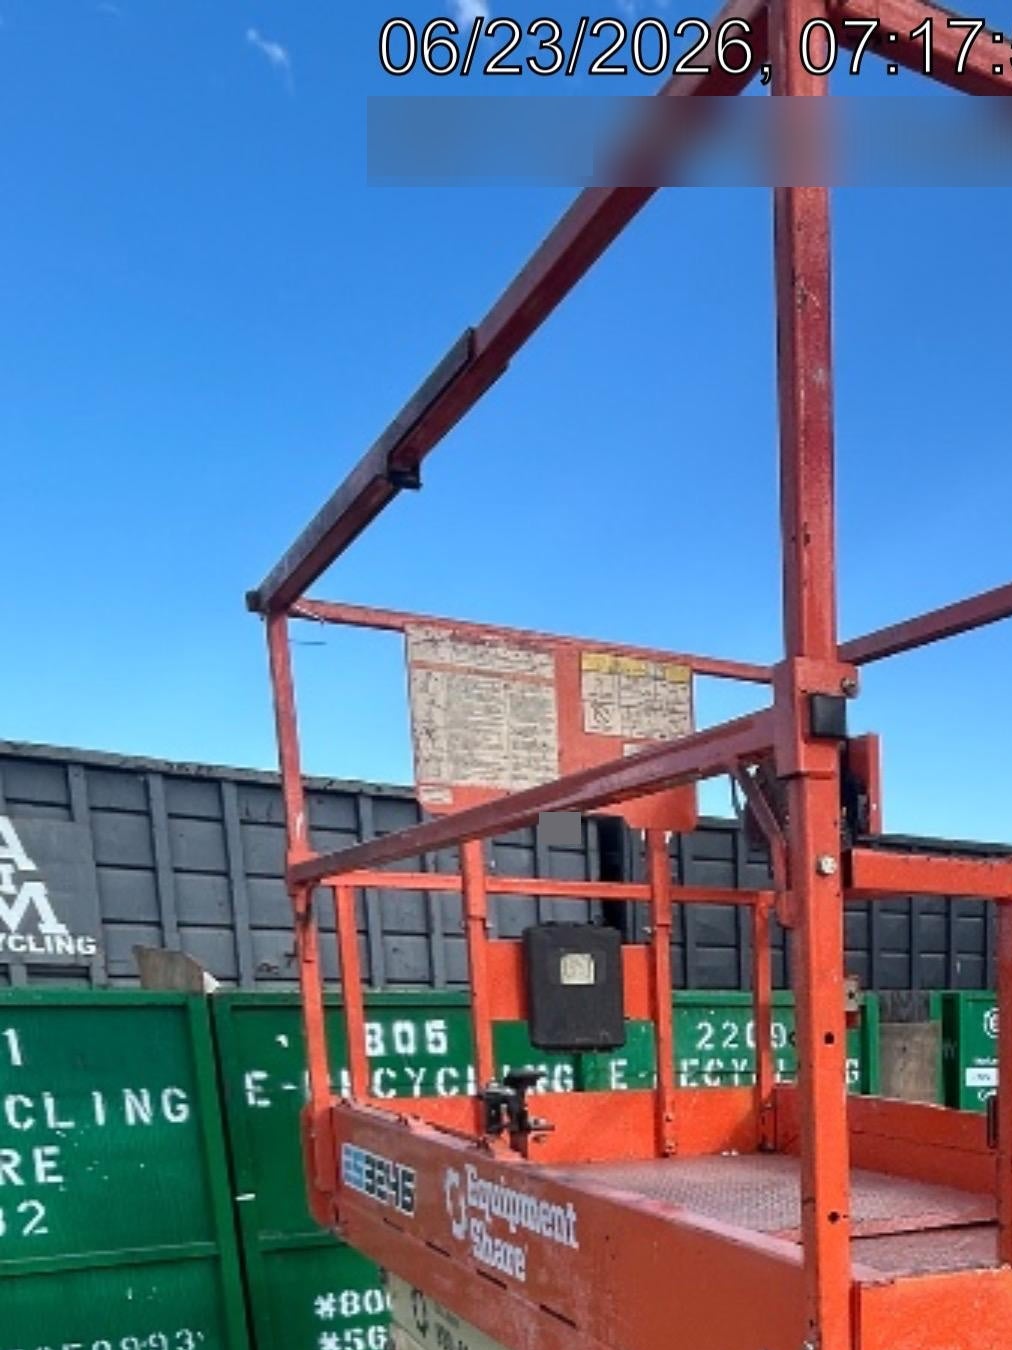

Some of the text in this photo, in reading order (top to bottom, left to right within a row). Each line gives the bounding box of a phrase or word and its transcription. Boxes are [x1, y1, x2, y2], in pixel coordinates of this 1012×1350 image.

[464, 1163, 580, 1249] Equipment
[470, 1217, 526, 1282] Share
[314, 1289, 391, 1319] #80
